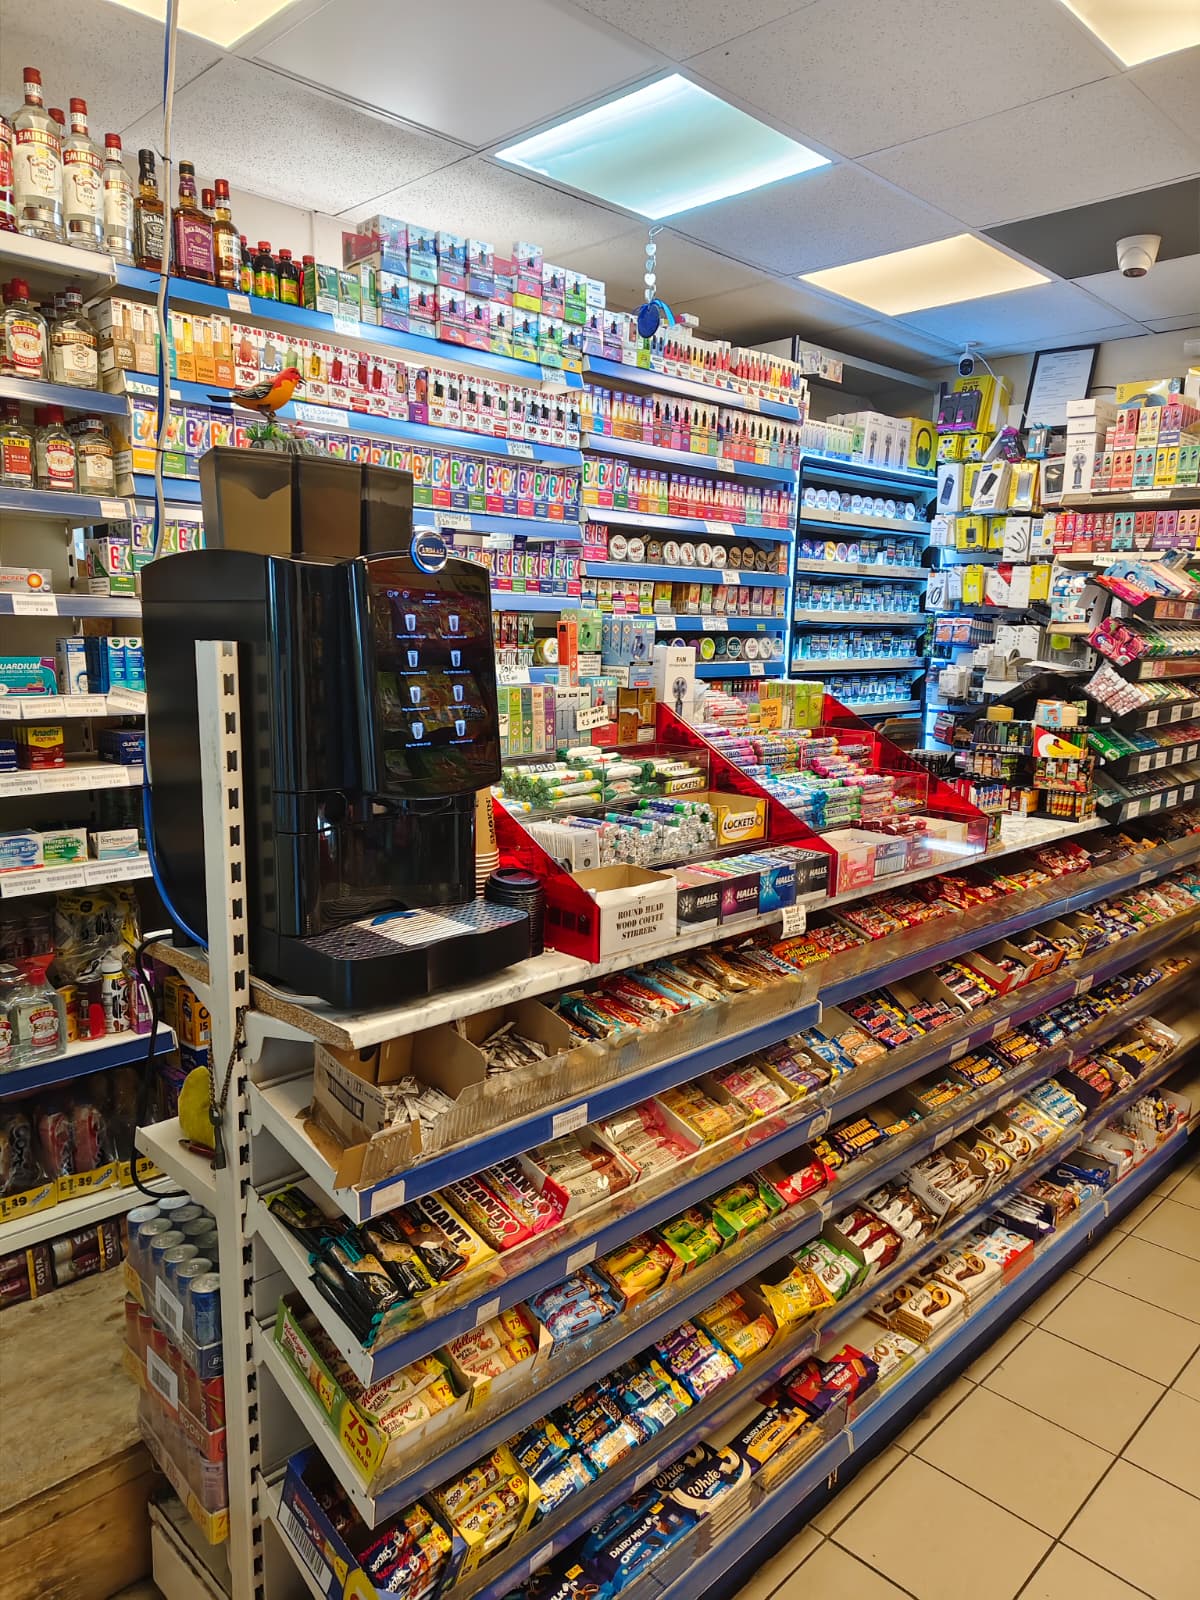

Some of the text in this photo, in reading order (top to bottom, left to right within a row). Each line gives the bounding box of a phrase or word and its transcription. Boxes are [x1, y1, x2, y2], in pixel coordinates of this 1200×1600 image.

[672, 781, 698, 792] LOCKETS
[723, 815, 755, 831] LOCKETS
[776, 874, 795, 885] HALLS
[809, 866, 828, 876] HALLS
[697, 893, 719, 905] HALLS
[736, 887, 758, 899] HALLS
[618, 902, 664, 920] ROUND HEAD
[616, 913, 664, 931] WOOD COFFEE
[621, 925, 657, 940] STIRRERS
[839, 1118, 872, 1141] YORKIE
[848, 1128, 881, 1150] YORKIE
[458, 1178, 513, 1223] GIANT
[420, 1195, 472, 1245] GIANT
[36, 1256, 45, 1286] COSTA
[509, 1317, 521, 1329] 79
[517, 1347, 529, 1359] 79
[438, 1385, 450, 1396] 79
[743, 1415, 773, 1444] DAIRY MILK
[511, 1478, 523, 1489] 69
[653, 1463, 686, 1489] White
[687, 1469, 721, 1497] White
[609, 1523, 650, 1559] DAIRY MILK
[620, 1542, 641, 1564] OREO
